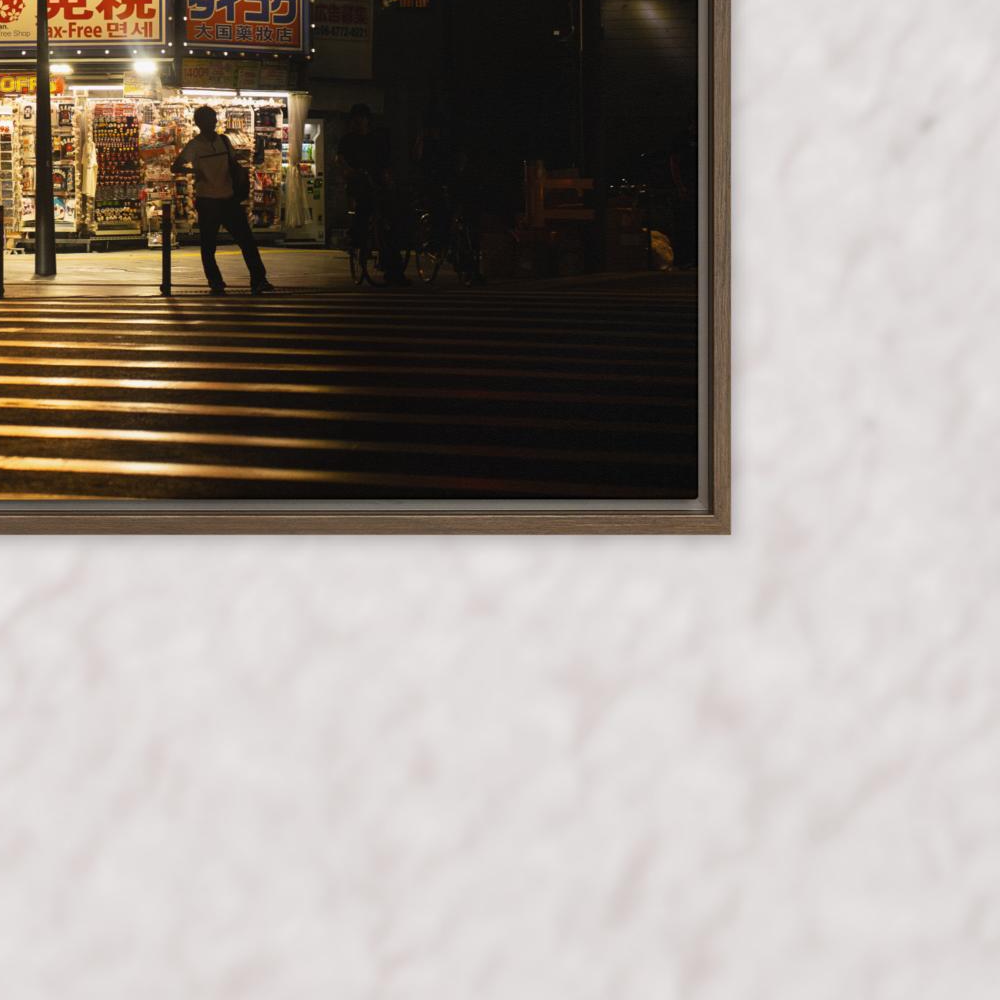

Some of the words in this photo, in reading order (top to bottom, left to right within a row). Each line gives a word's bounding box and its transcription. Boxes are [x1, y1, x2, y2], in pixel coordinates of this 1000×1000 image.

[13, 30, 31, 38] Shop
[47, 22, 103, 39] ax-Free
[194, 22, 294, 43] 大国藥妝店
